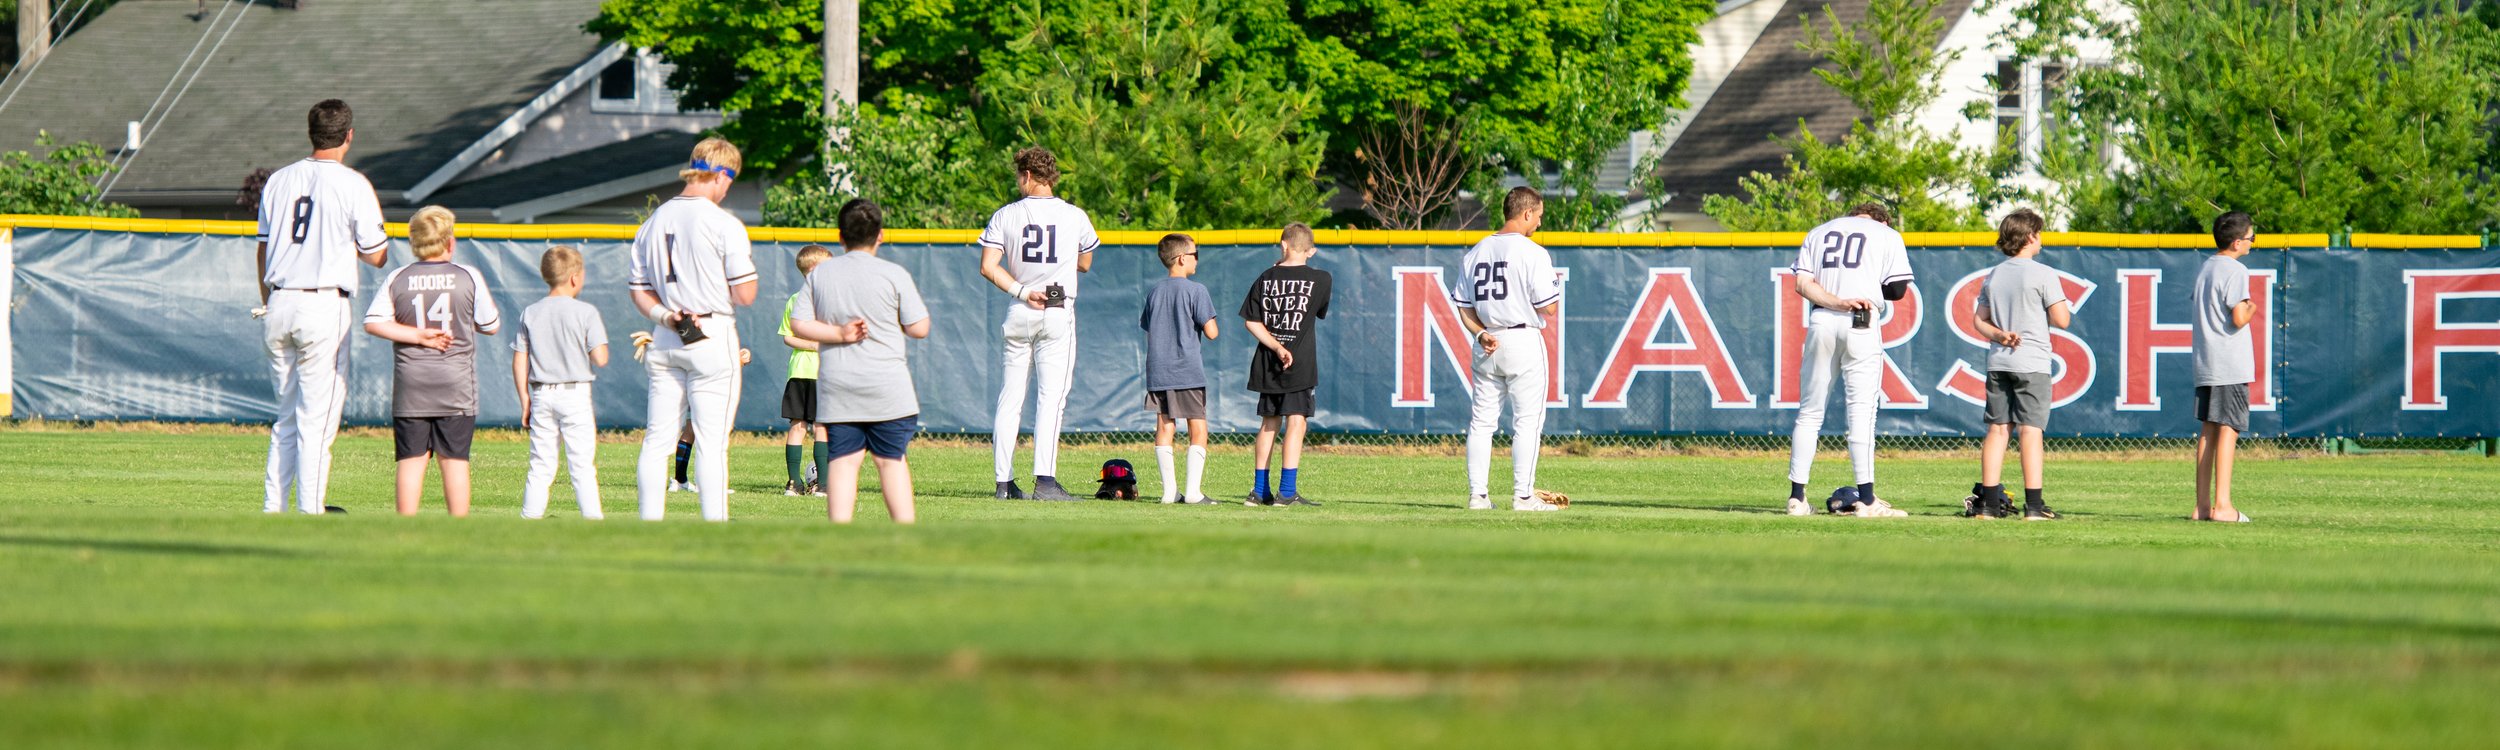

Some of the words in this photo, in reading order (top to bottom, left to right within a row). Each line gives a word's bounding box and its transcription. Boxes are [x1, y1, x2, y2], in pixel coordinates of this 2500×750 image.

[292, 195, 314, 244] 8
[1022, 224, 1058, 263] 21
[1822, 230, 1867, 269] 20
[407, 273, 456, 291] MOORE
[1263, 279, 1315, 297] FAITH
[1474, 261, 1508, 301] 25
[411, 292, 454, 336] 14
[1262, 295, 1309, 312] OVER
[1264, 311, 1303, 331] FEAR
